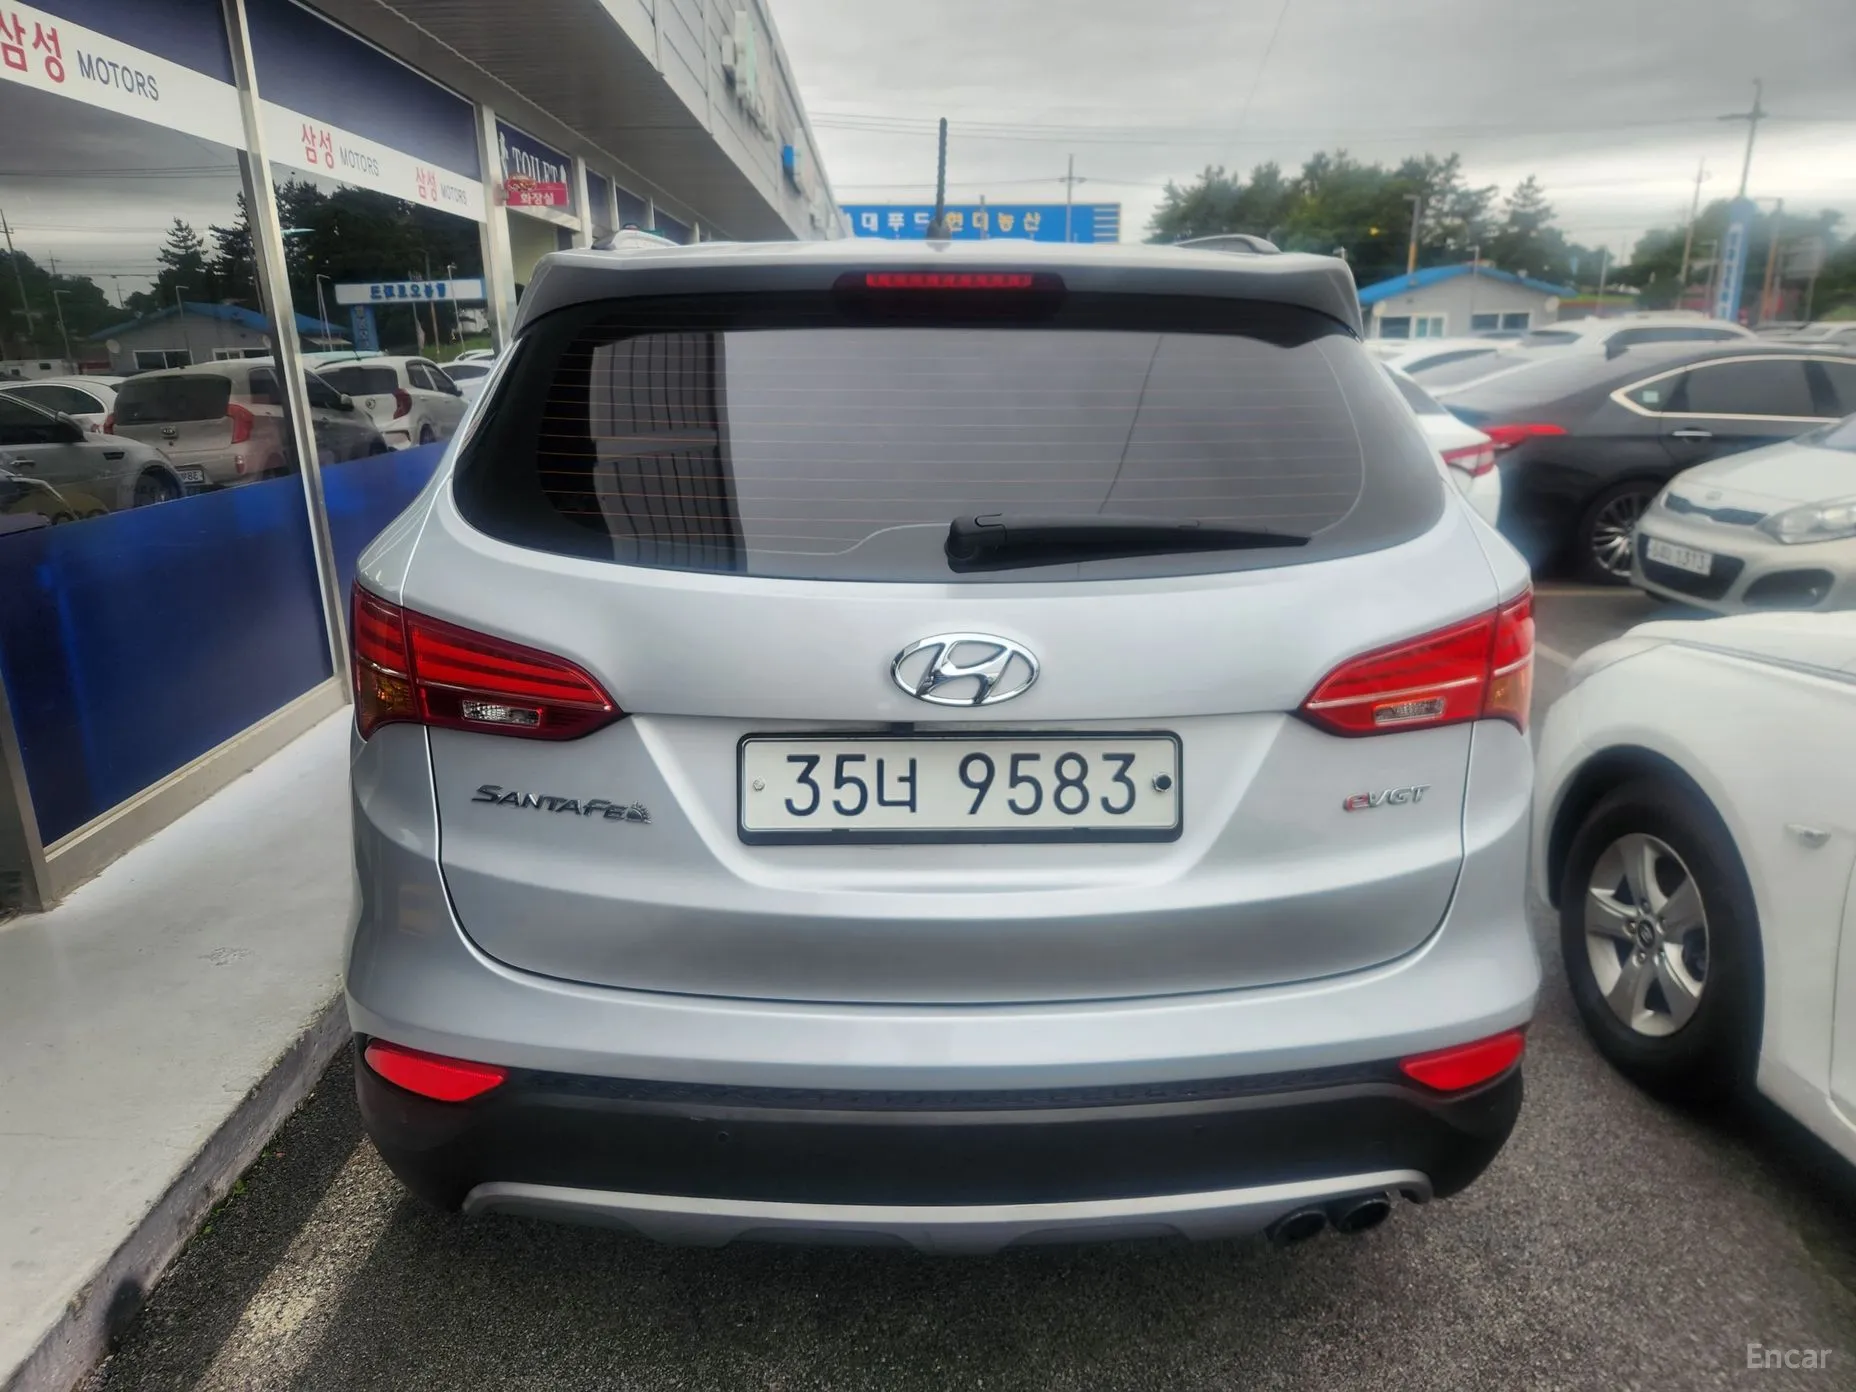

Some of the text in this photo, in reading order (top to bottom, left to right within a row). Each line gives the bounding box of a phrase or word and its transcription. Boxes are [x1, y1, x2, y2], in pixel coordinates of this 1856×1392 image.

[0, 10, 160, 101] 삼성 MOTORS
[301, 123, 380, 176] 삼성 MOTORS
[416, 166, 468, 205] 삼성 MOTORS
[784, 751, 1136, 817] 35너 9583
